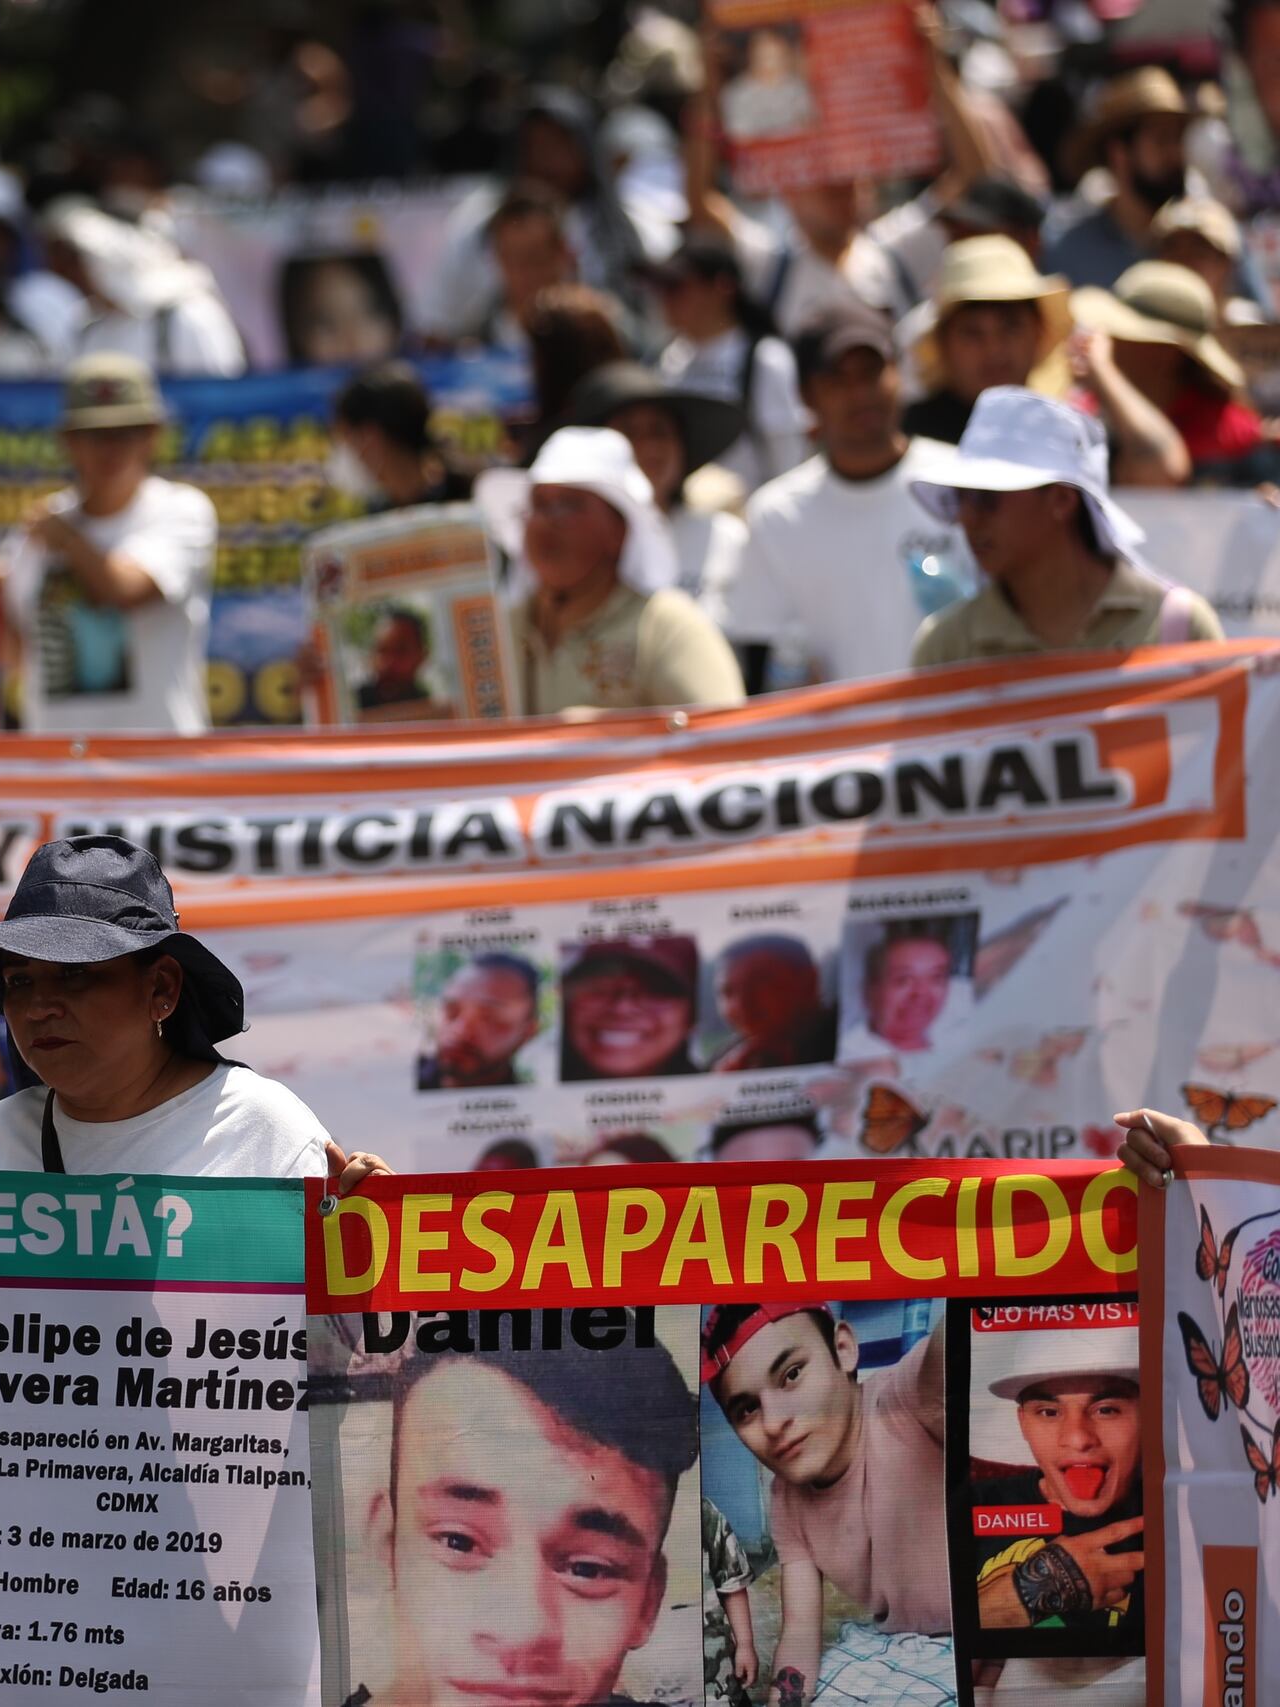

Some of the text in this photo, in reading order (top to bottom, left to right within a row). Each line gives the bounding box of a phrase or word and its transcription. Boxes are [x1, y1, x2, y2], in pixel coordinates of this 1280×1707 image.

[70, 810, 511, 874] STICIA
[548, 738, 1119, 852] NACIONAL
[323, 1164, 1140, 1297] DESAPARECIDO
[1079, 1300, 1140, 1321] VIST
[115, 1317, 173, 1358] de
[185, 1315, 308, 1361] Jesús
[104, 1432, 130, 1451] en
[134, 1430, 166, 1452] Av.
[171, 1432, 290, 1457] Margaritas,
[25, 1458, 135, 1485] Primavera,
[138, 1461, 221, 1485] Alcaldía
[224, 1464, 312, 1490] Tlalpan,
[95, 1491, 160, 1514] CDMX
[977, 1512, 1050, 1529] DANIEL
[7, 1525, 22, 1546] 3
[28, 1526, 56, 1548] de
[61, 1532, 128, 1552] marzo
[132, 1529, 160, 1552] de
[164, 1531, 224, 1554] 2019
[110, 1576, 273, 1604] Edad: 16 años
[26, 1620, 79, 1643] 1.76
[83, 1624, 126, 1645] mts
[58, 1665, 150, 1693] Delgada
